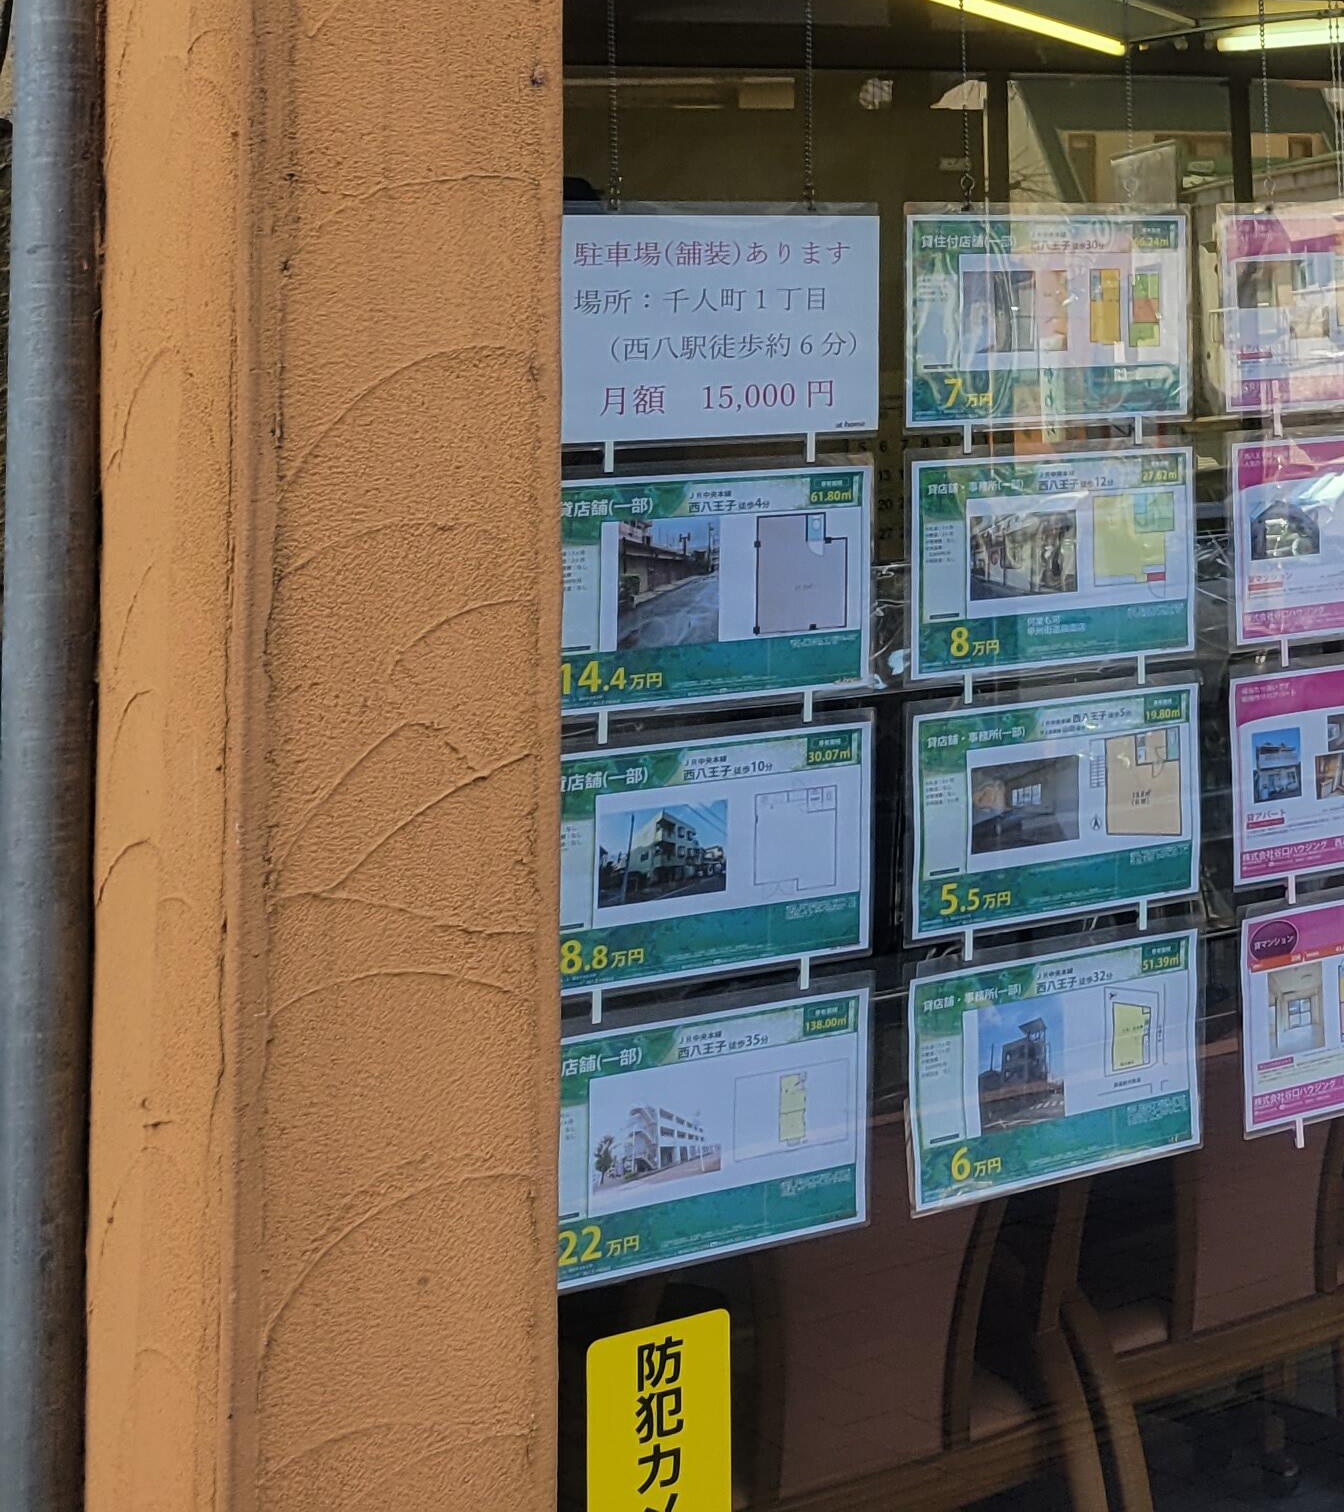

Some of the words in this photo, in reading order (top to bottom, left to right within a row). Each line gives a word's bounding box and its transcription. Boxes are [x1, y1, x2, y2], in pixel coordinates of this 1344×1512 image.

[573, 241, 851, 267] 駐車場(舗装)あります
[600, 385, 667, 416] 月額
[703, 379, 835, 413] 15,000円
[688, 499, 737, 514] 西八王子
[950, 626, 1001, 658] 8万円
[683, 765, 733, 782] 西八王子
[939, 881, 1012, 916] 5.5万円
[1036, 976, 1078, 994] 西八王子
[560, 1048, 642, 1078] 店舗(一部)
[677, 1039, 727, 1061] 西八王子
[951, 1146, 1002, 1181] 6万円
[558, 1225, 640, 1268] 22万円
